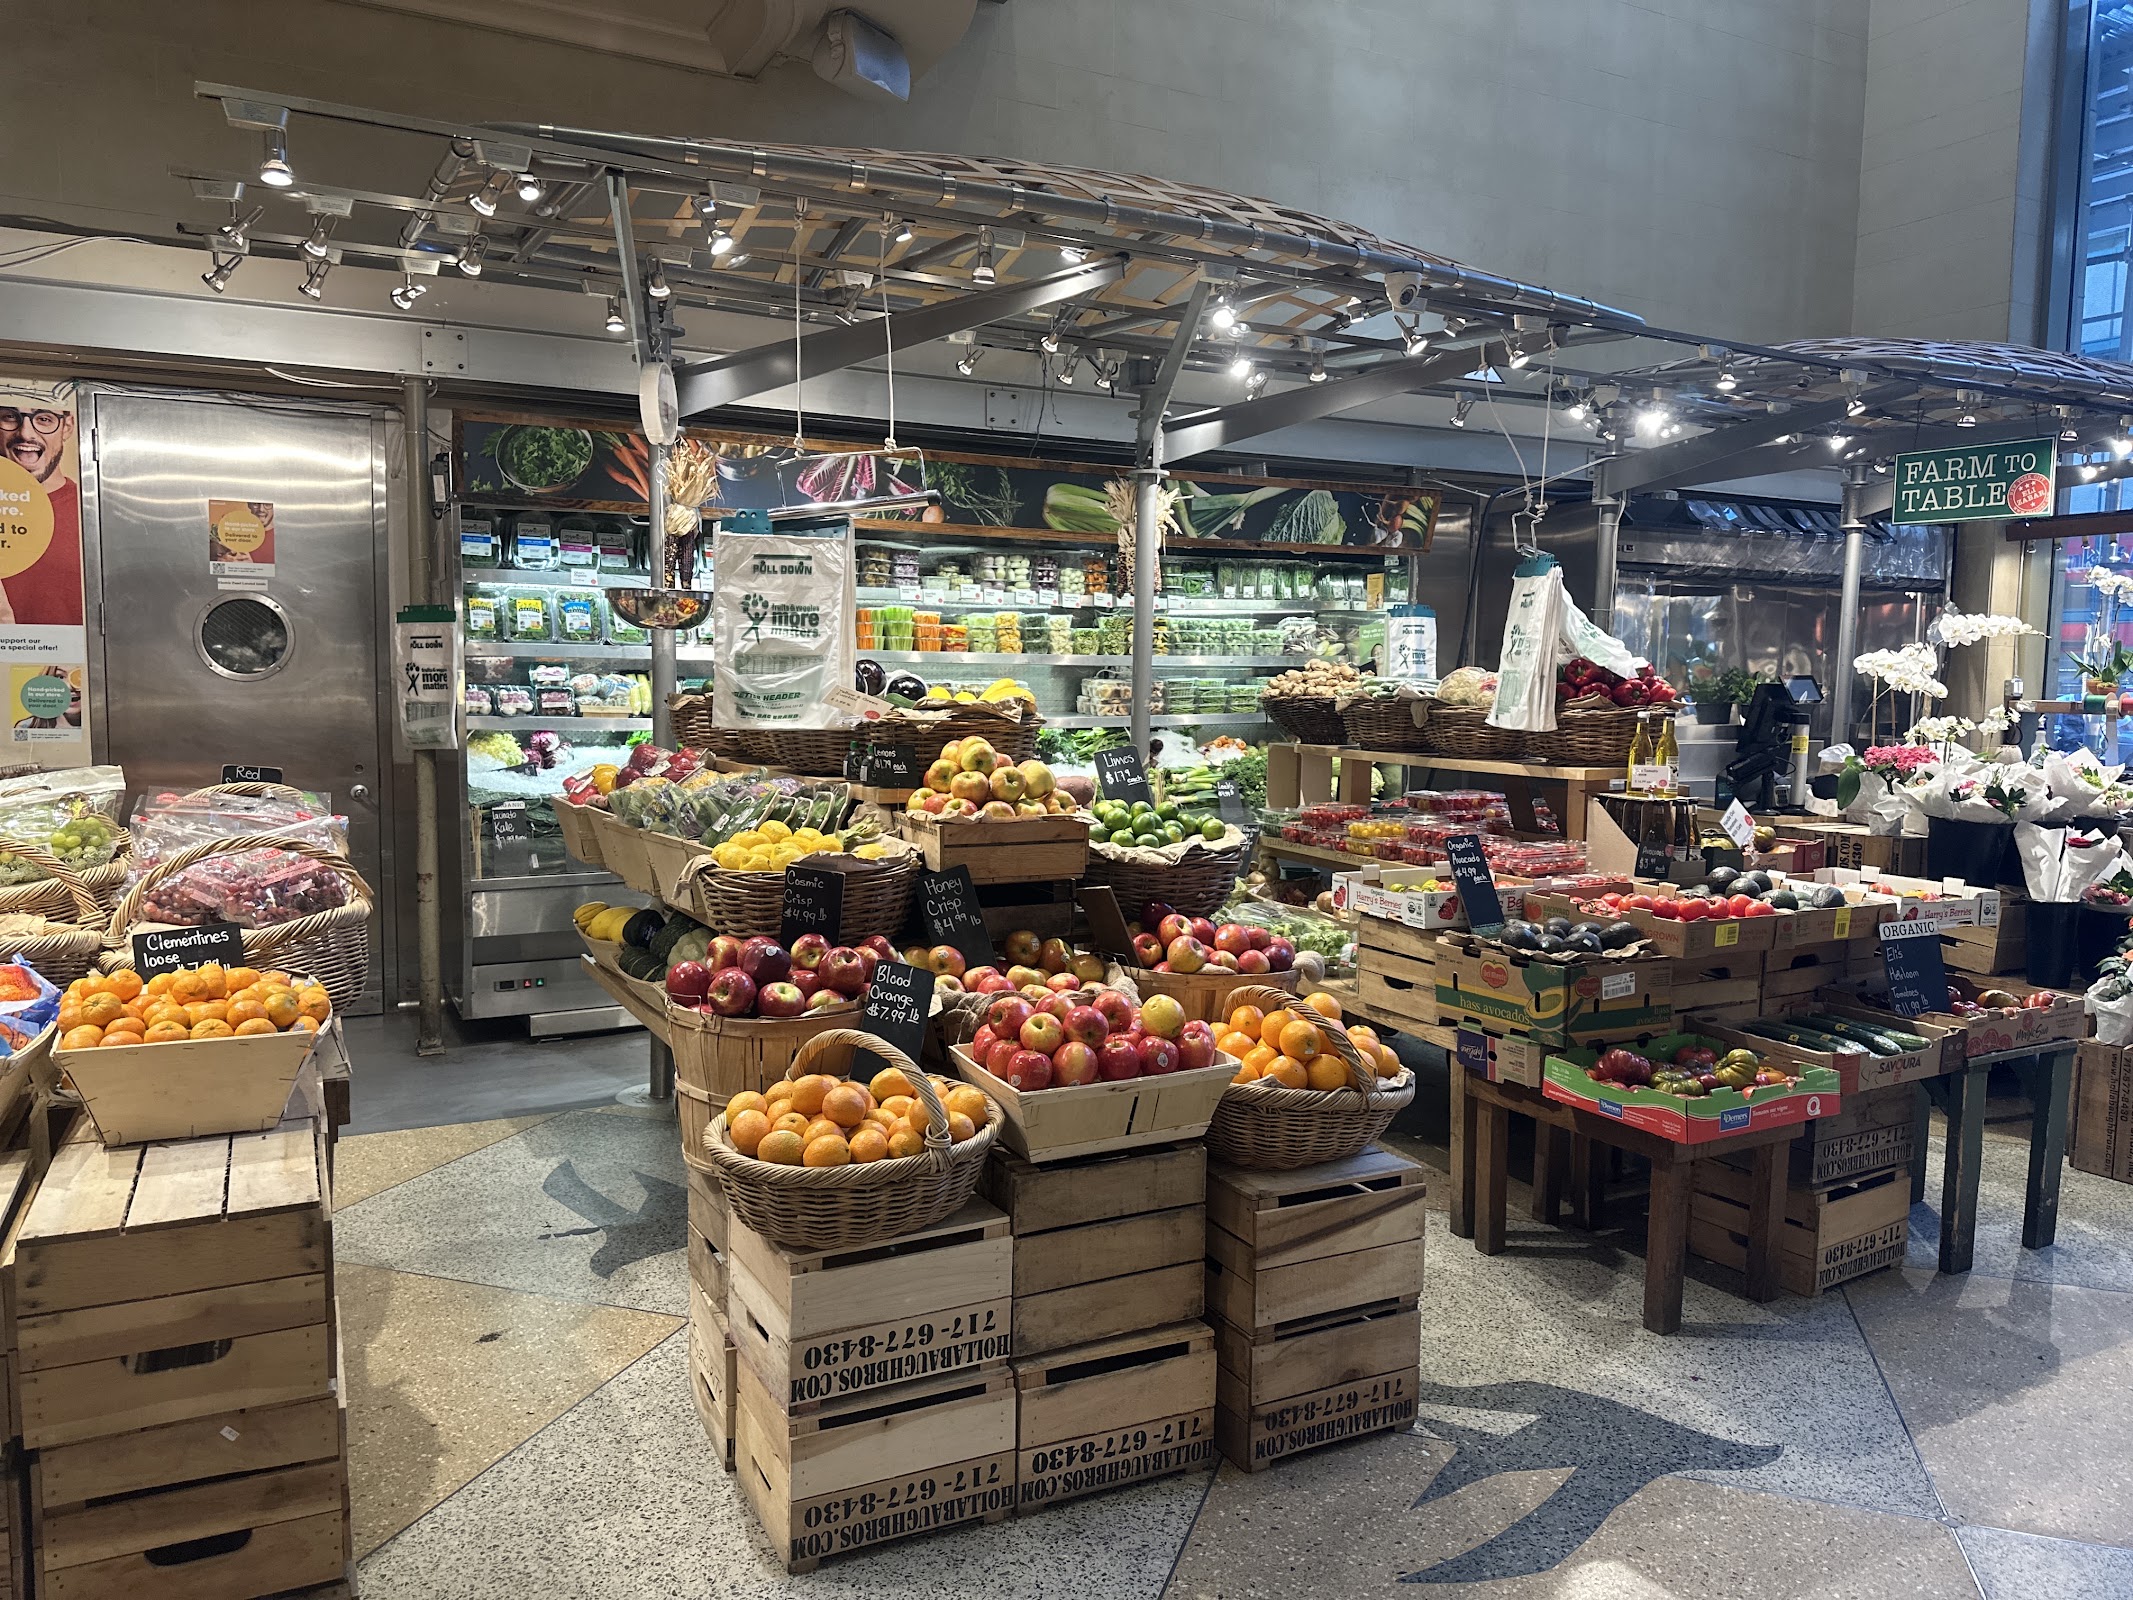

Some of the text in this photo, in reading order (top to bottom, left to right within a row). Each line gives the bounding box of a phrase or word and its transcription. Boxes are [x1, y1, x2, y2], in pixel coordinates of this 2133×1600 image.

[1904, 453, 2036, 485] FARM TO
[1902, 482, 2007, 513] TABLE
[2017, 490, 2045, 506] ZABAR
[2022, 487, 2037, 497] ELI
[11, 524, 27, 535] to
[753, 560, 812, 575] PULL DOWN
[771, 611, 820, 627] more
[422, 672, 448, 683] more
[762, 692, 801, 701] HEADER
[874, 746, 896, 758] Lemons
[893, 762, 908, 771] each
[1103, 753, 1135, 768] Limes
[236, 766, 261, 781] Red
[494, 821, 515, 833] Kale
[1447, 838, 1474, 851] Organic
[1452, 852, 1480, 865] Avocado
[786, 869, 824, 889] Cosmic
[1455, 867, 1487, 882] $4.99 each
[924, 877, 963, 895] Honey
[1371, 888, 1384, 896] Organic
[783, 889, 813, 905] Crisp
[1356, 891, 1402, 909] Harry's Berries
[783, 907, 827, 925] $4.99 lb
[1543, 904, 1570, 916] BACKYARD
[1924, 908, 1972, 920] Harry's Berries
[970, 915, 981, 927] lb
[1647, 929, 1679, 942] GROWN
[1883, 921, 1935, 938] ORGANIC
[146, 930, 230, 951] Clementines
[143, 953, 180, 968] loose
[1886, 944, 1903, 962] Eli's
[877, 965, 914, 987] Blood
[1889, 966, 1919, 980] Heirloom
[870, 985, 914, 1009] Orange
[1891, 986, 1919, 998] Tomatoes
[1460, 995, 1530, 1024] hass avocados
[1654, 1005, 1670, 1015] hass
[1895, 994, 1928, 1016] $11.99 lb
[866, 1003, 920, 1024] $7.99 lb
[1636, 1015, 1670, 1025] avocados
[1879, 1056, 1921, 1075] SAVOURA
[1817, 1143, 1911, 1180] HOLLABAUGHBROS.COM
[1818, 1241, 1905, 1287] HOLLABAUGHBROS.COM
[804, 1310, 997, 1369] 717-677-8430
[791, 1334, 1010, 1402] HOLLABAUGHBROS.COM
[1265, 1378, 1404, 1430] 717-677-8430
[1255, 1399, 1412, 1459] HOLLABAUGHBROS.COM
[1033, 1417, 1202, 1474] 717-677-8430
[1020, 1440, 1214, 1503] HOLLABAUGHBROS.COM
[805, 1463, 1000, 1528] 717-677-8430
[791, 1484, 1014, 1561] HOLLABAUGHBROS.COM
